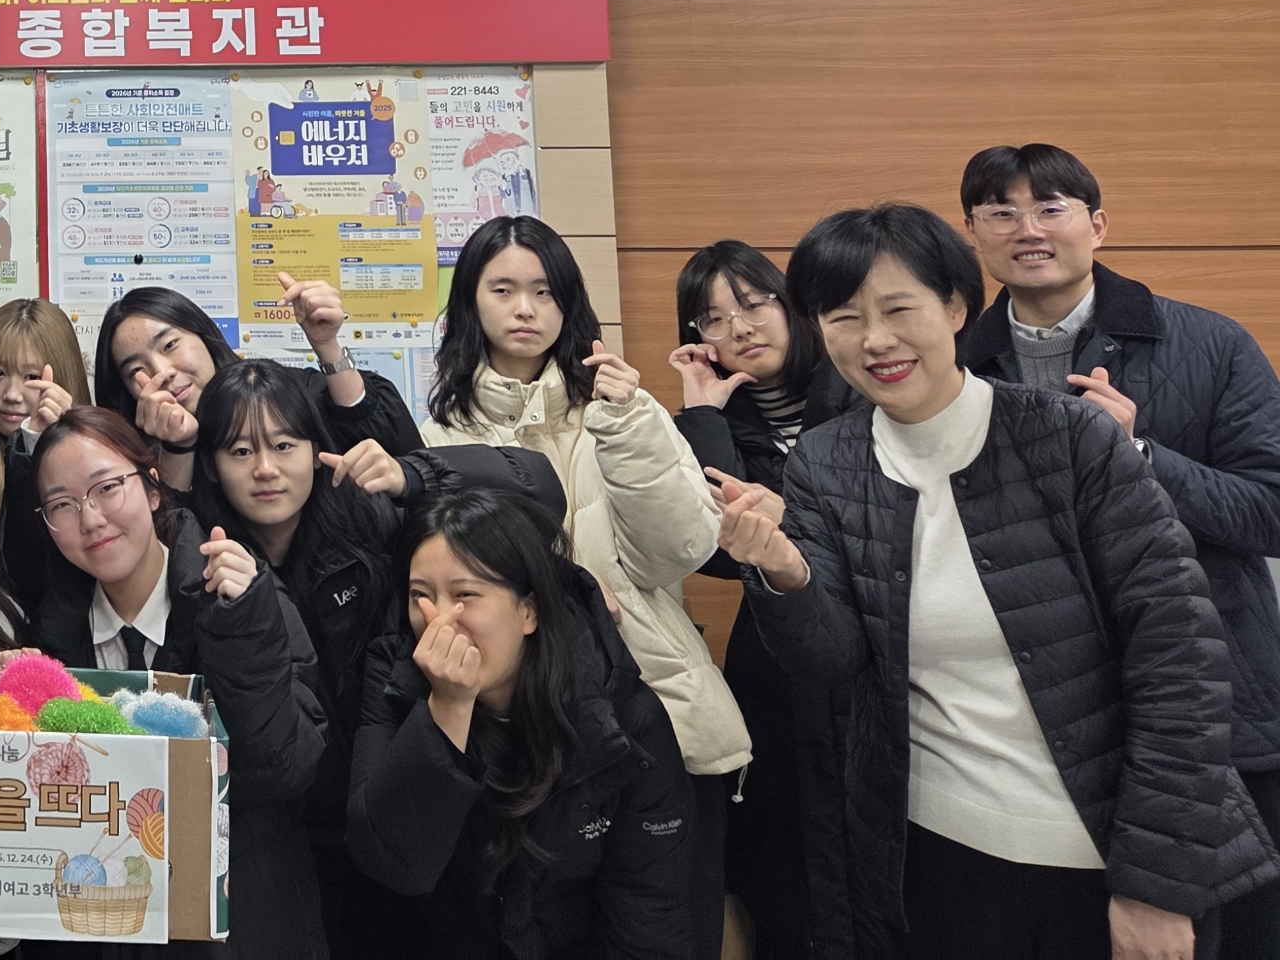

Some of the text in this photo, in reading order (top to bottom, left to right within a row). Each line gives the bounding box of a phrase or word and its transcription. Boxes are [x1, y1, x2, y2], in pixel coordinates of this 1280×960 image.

[450, 86, 499, 96] 221-8443
[85, 102, 204, 117] 든든한 사회안전매트
[429, 100, 523, 113] 들의 고민을 시원하게
[57, 119, 232, 134] 기초생활보장이 더욱 단단해집니다.
[434, 115, 500, 129] 풀어드립니다.
[301, 120, 367, 142] 에너지
[302, 144, 368, 166] 바우처
[263, 310, 296, 320] 1600-
[333, 585, 358, 607] Lee
[35, 781, 127, 836] 뜨다
[642, 818, 683, 831] Calvin Klein
[7, 853, 19, 862] 12.
[21, 853, 53, 866] 24.(수)
[33, 883, 82, 899] 3학년부
